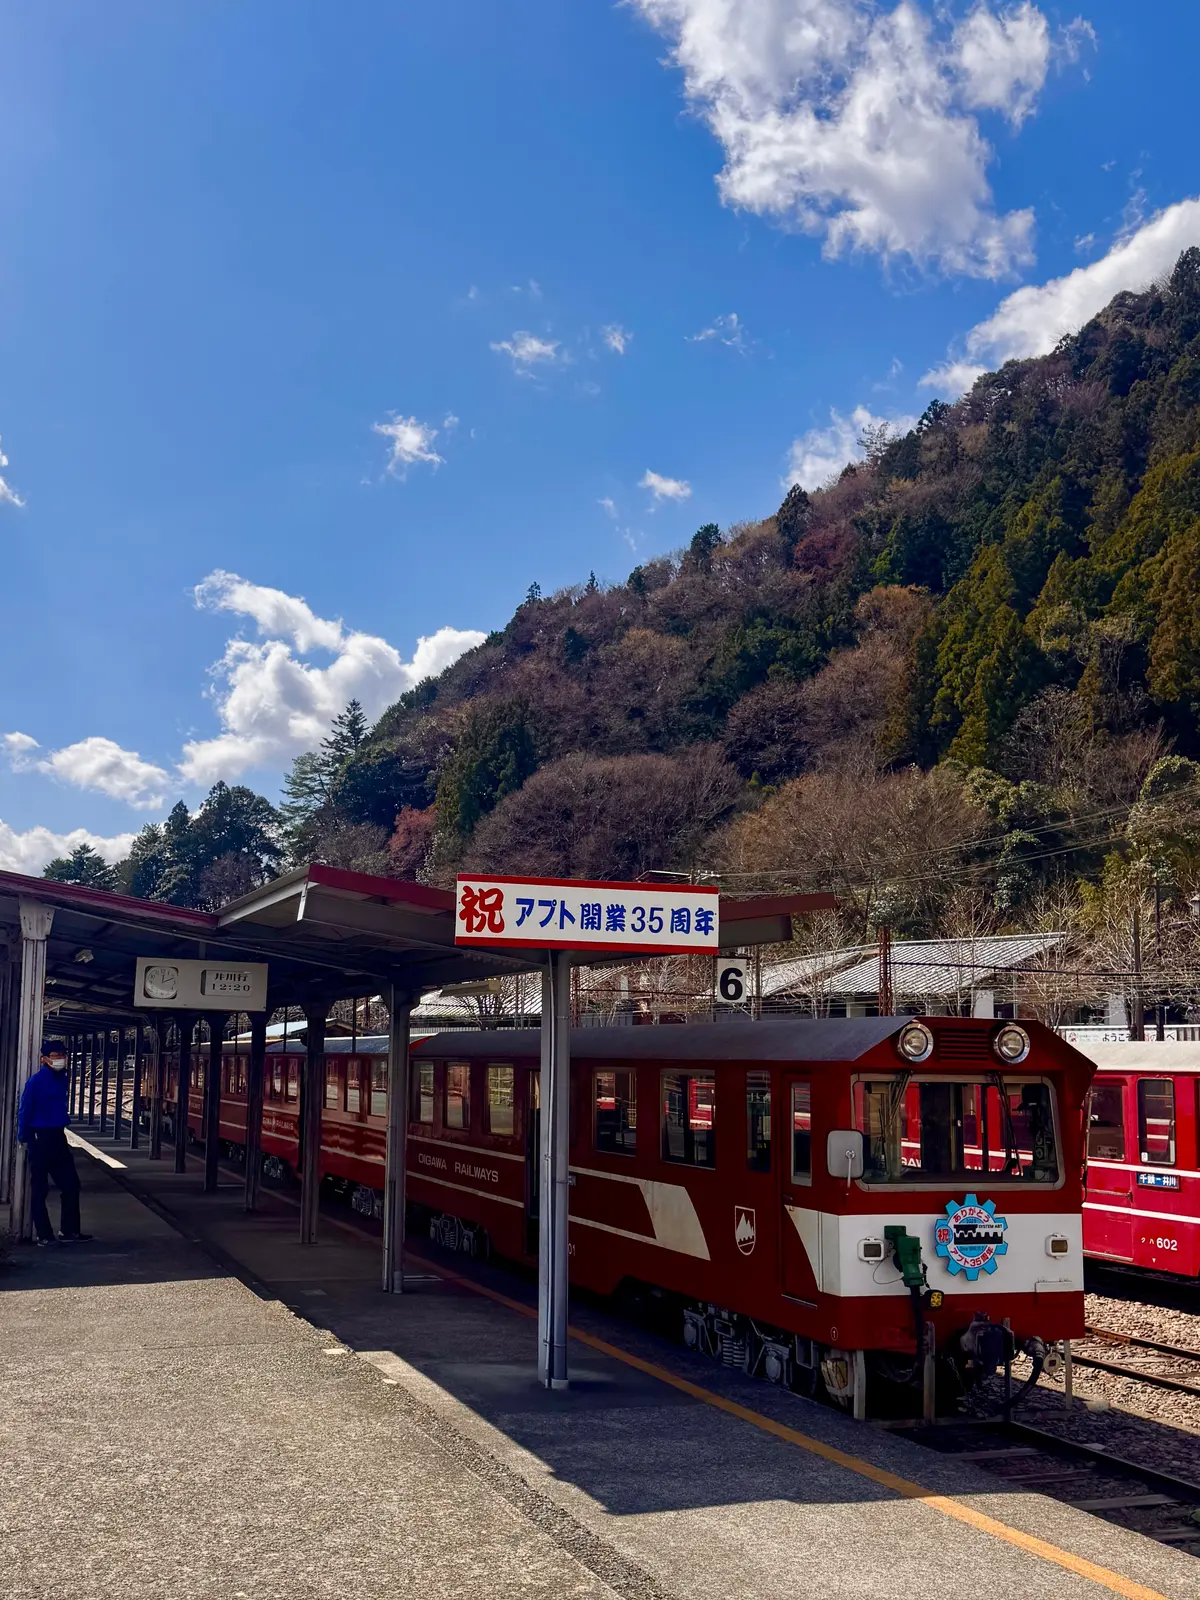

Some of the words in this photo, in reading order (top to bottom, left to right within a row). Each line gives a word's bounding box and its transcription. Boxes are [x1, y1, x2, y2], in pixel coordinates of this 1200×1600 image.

[459, 885, 505, 934] 祝
[515, 897, 716, 936] アプト開業35周年
[212, 983, 251, 992] 12:20
[719, 967, 744, 1001] 6
[418, 1153, 448, 1170] OIGAWA
[953, 1208, 990, 1223] ありがとう
[937, 1229, 949, 1242] 祝
[1156, 1237, 1178, 1251] 602
